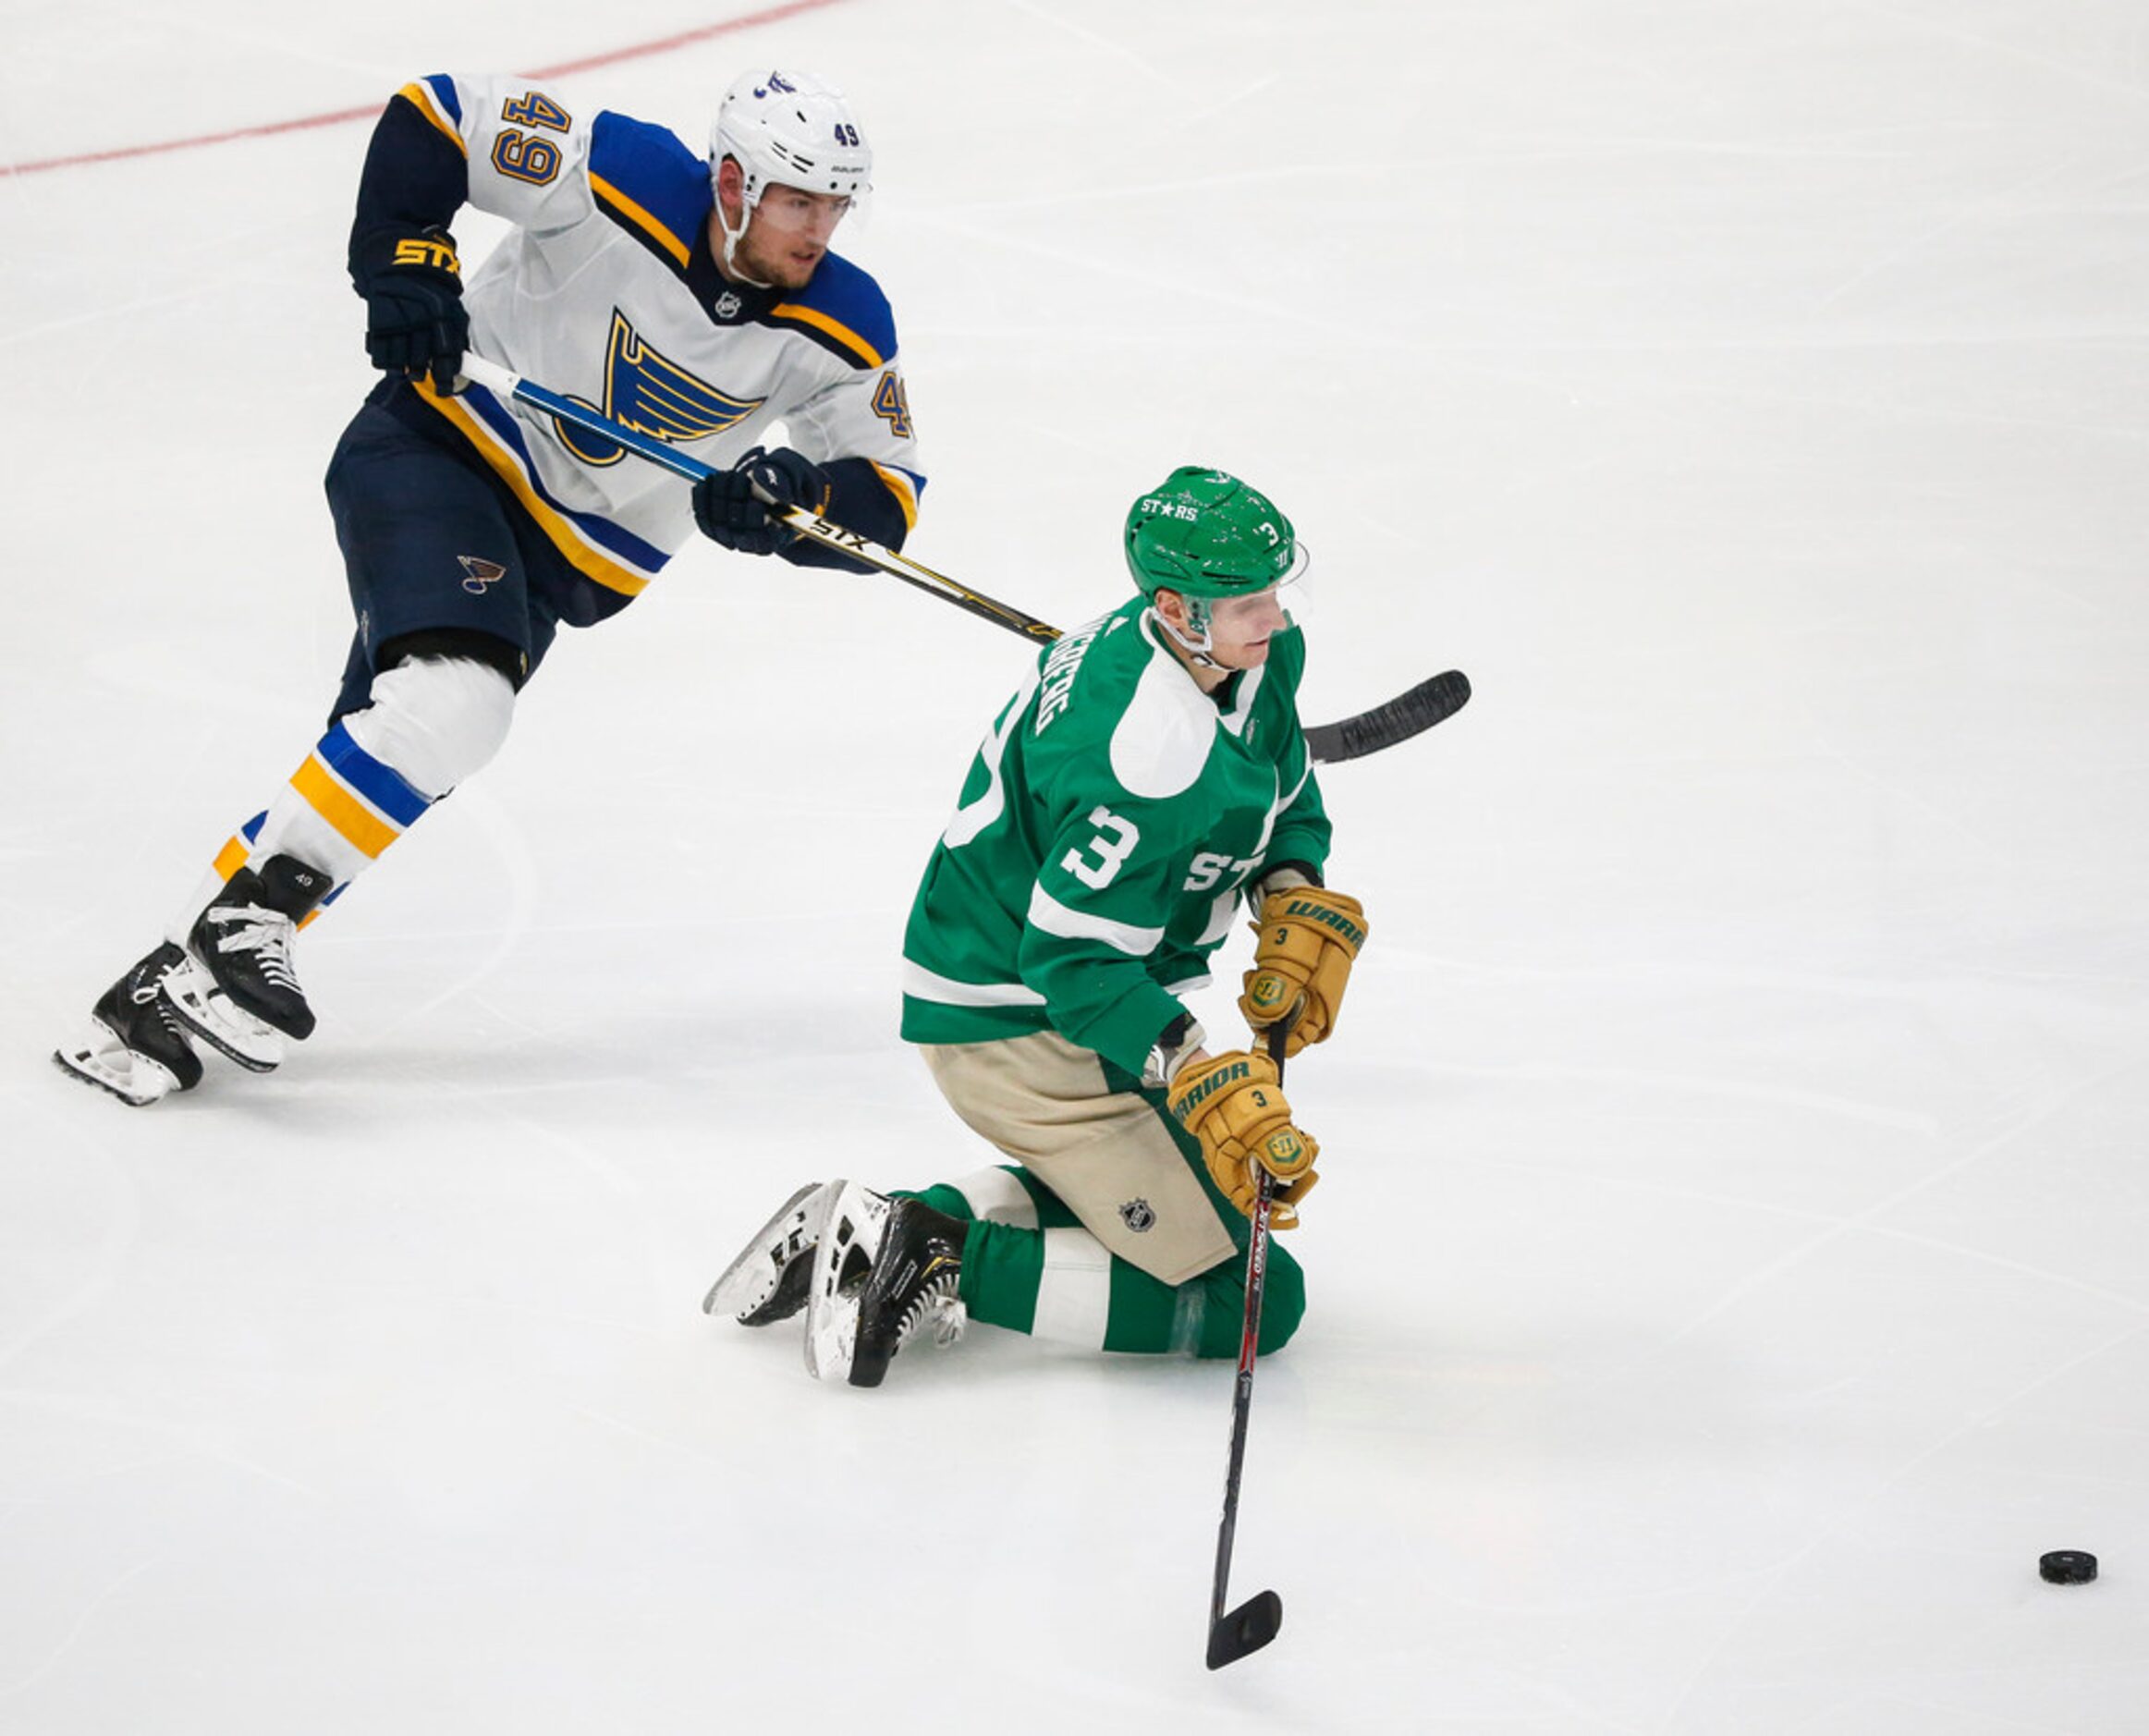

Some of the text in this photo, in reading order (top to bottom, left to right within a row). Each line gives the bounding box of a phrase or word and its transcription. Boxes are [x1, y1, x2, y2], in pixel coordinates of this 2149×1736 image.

[491, 92, 571, 187] 49
[835, 123, 860, 146] 49
[392, 238, 460, 274] STX
[871, 371, 912, 440] 4
[810, 518, 869, 552] STX
[1259, 521, 1279, 546] 3
[1060, 805, 1141, 890] 3
[295, 874, 313, 887] 49
[1275, 928, 1288, 946] 3
[1252, 1090, 1267, 1107] 3
